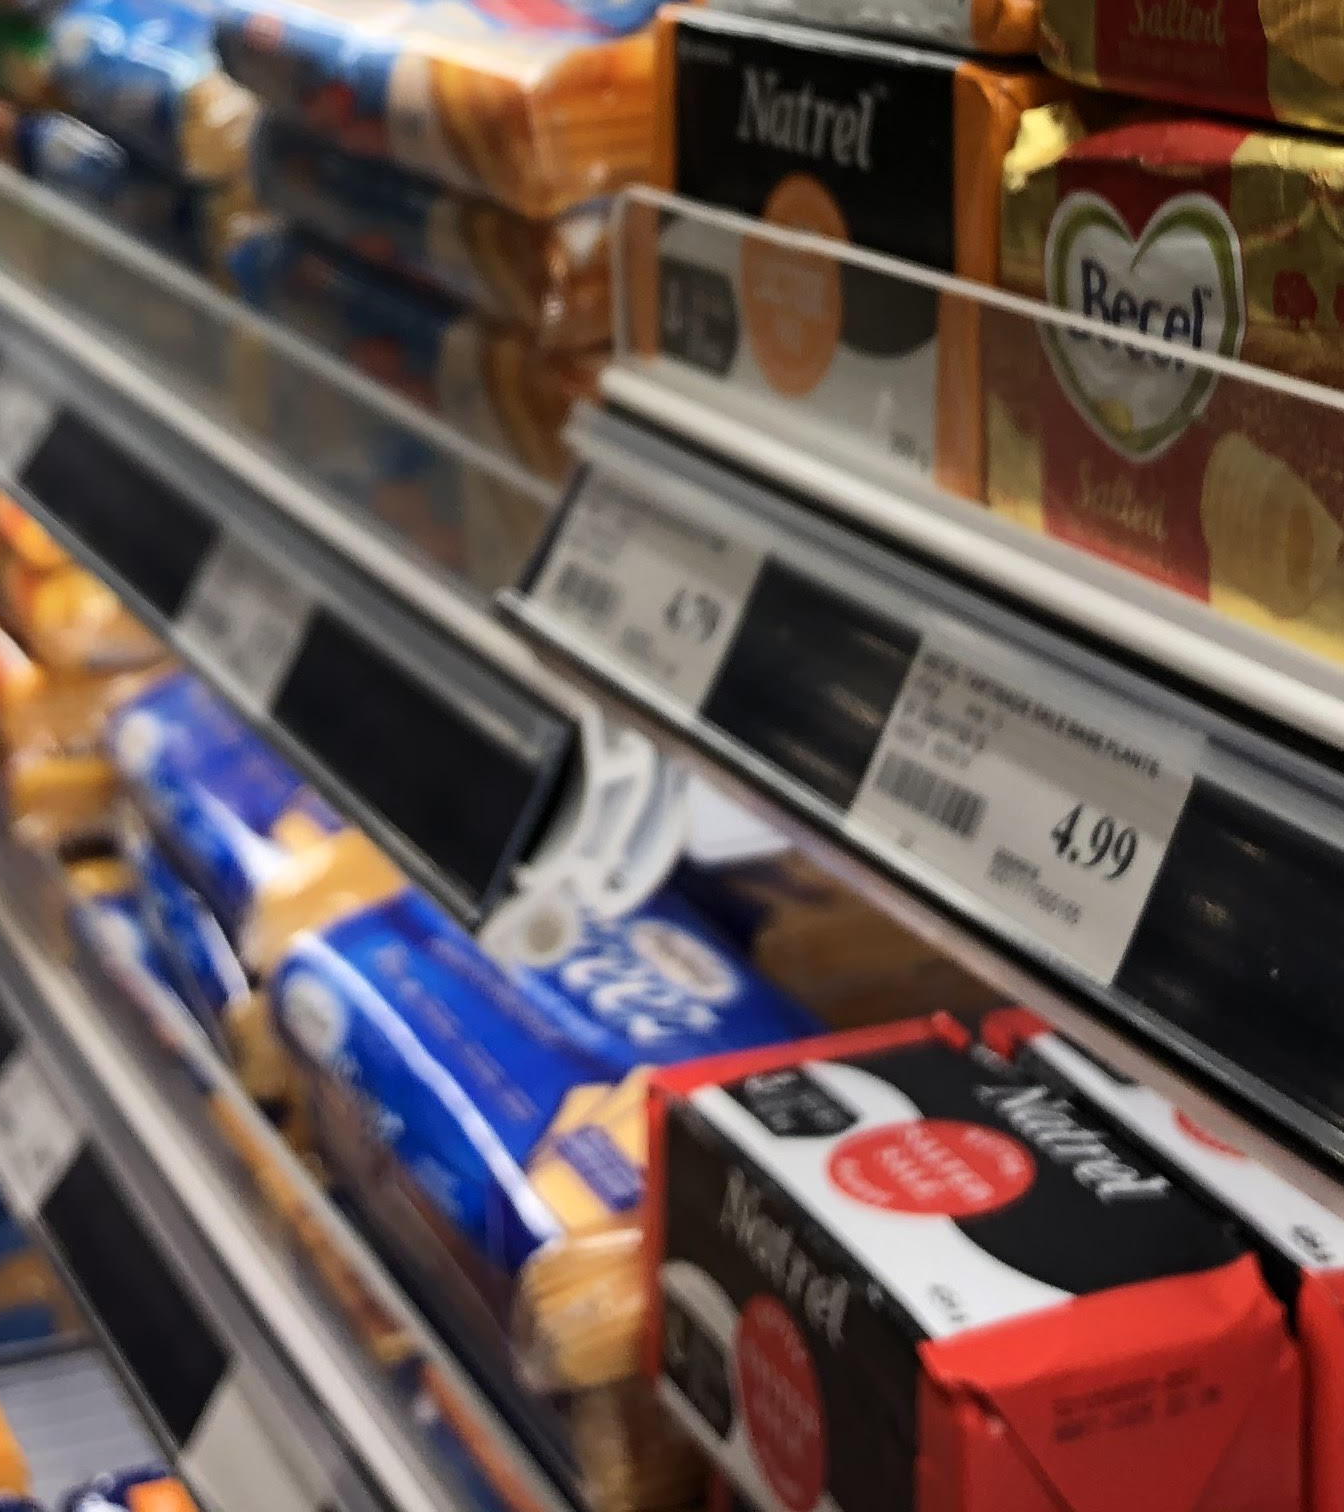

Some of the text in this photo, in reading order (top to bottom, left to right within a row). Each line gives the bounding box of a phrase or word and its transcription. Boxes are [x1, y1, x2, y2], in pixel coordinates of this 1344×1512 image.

[736, 66, 875, 172] Natrel
[1072, 255, 1206, 373] Becel
[1049, 801, 1139, 882] 4.99
[974, 1084, 1172, 1202] Natrel
